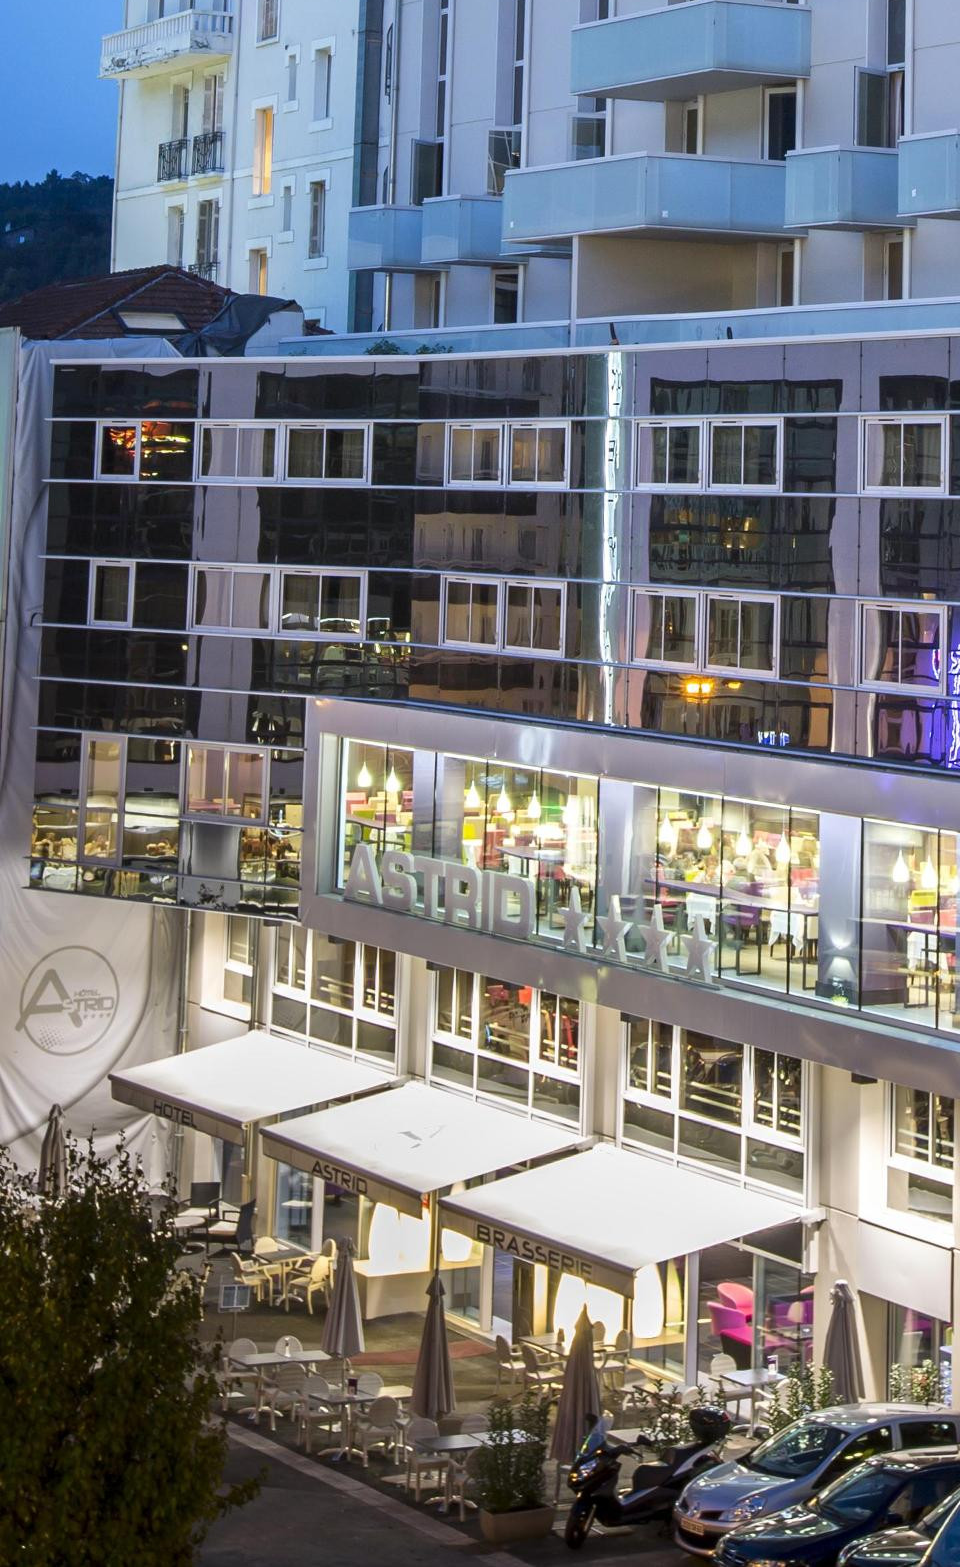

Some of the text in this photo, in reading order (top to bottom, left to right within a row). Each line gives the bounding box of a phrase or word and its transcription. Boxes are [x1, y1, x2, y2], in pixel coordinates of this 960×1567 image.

[343, 843, 536, 939] ASTRID
[153, 1098, 197, 1128] HOTEL
[312, 1160, 367, 1194] ASTRID
[476, 1224, 592, 1282] BRASSERIE
